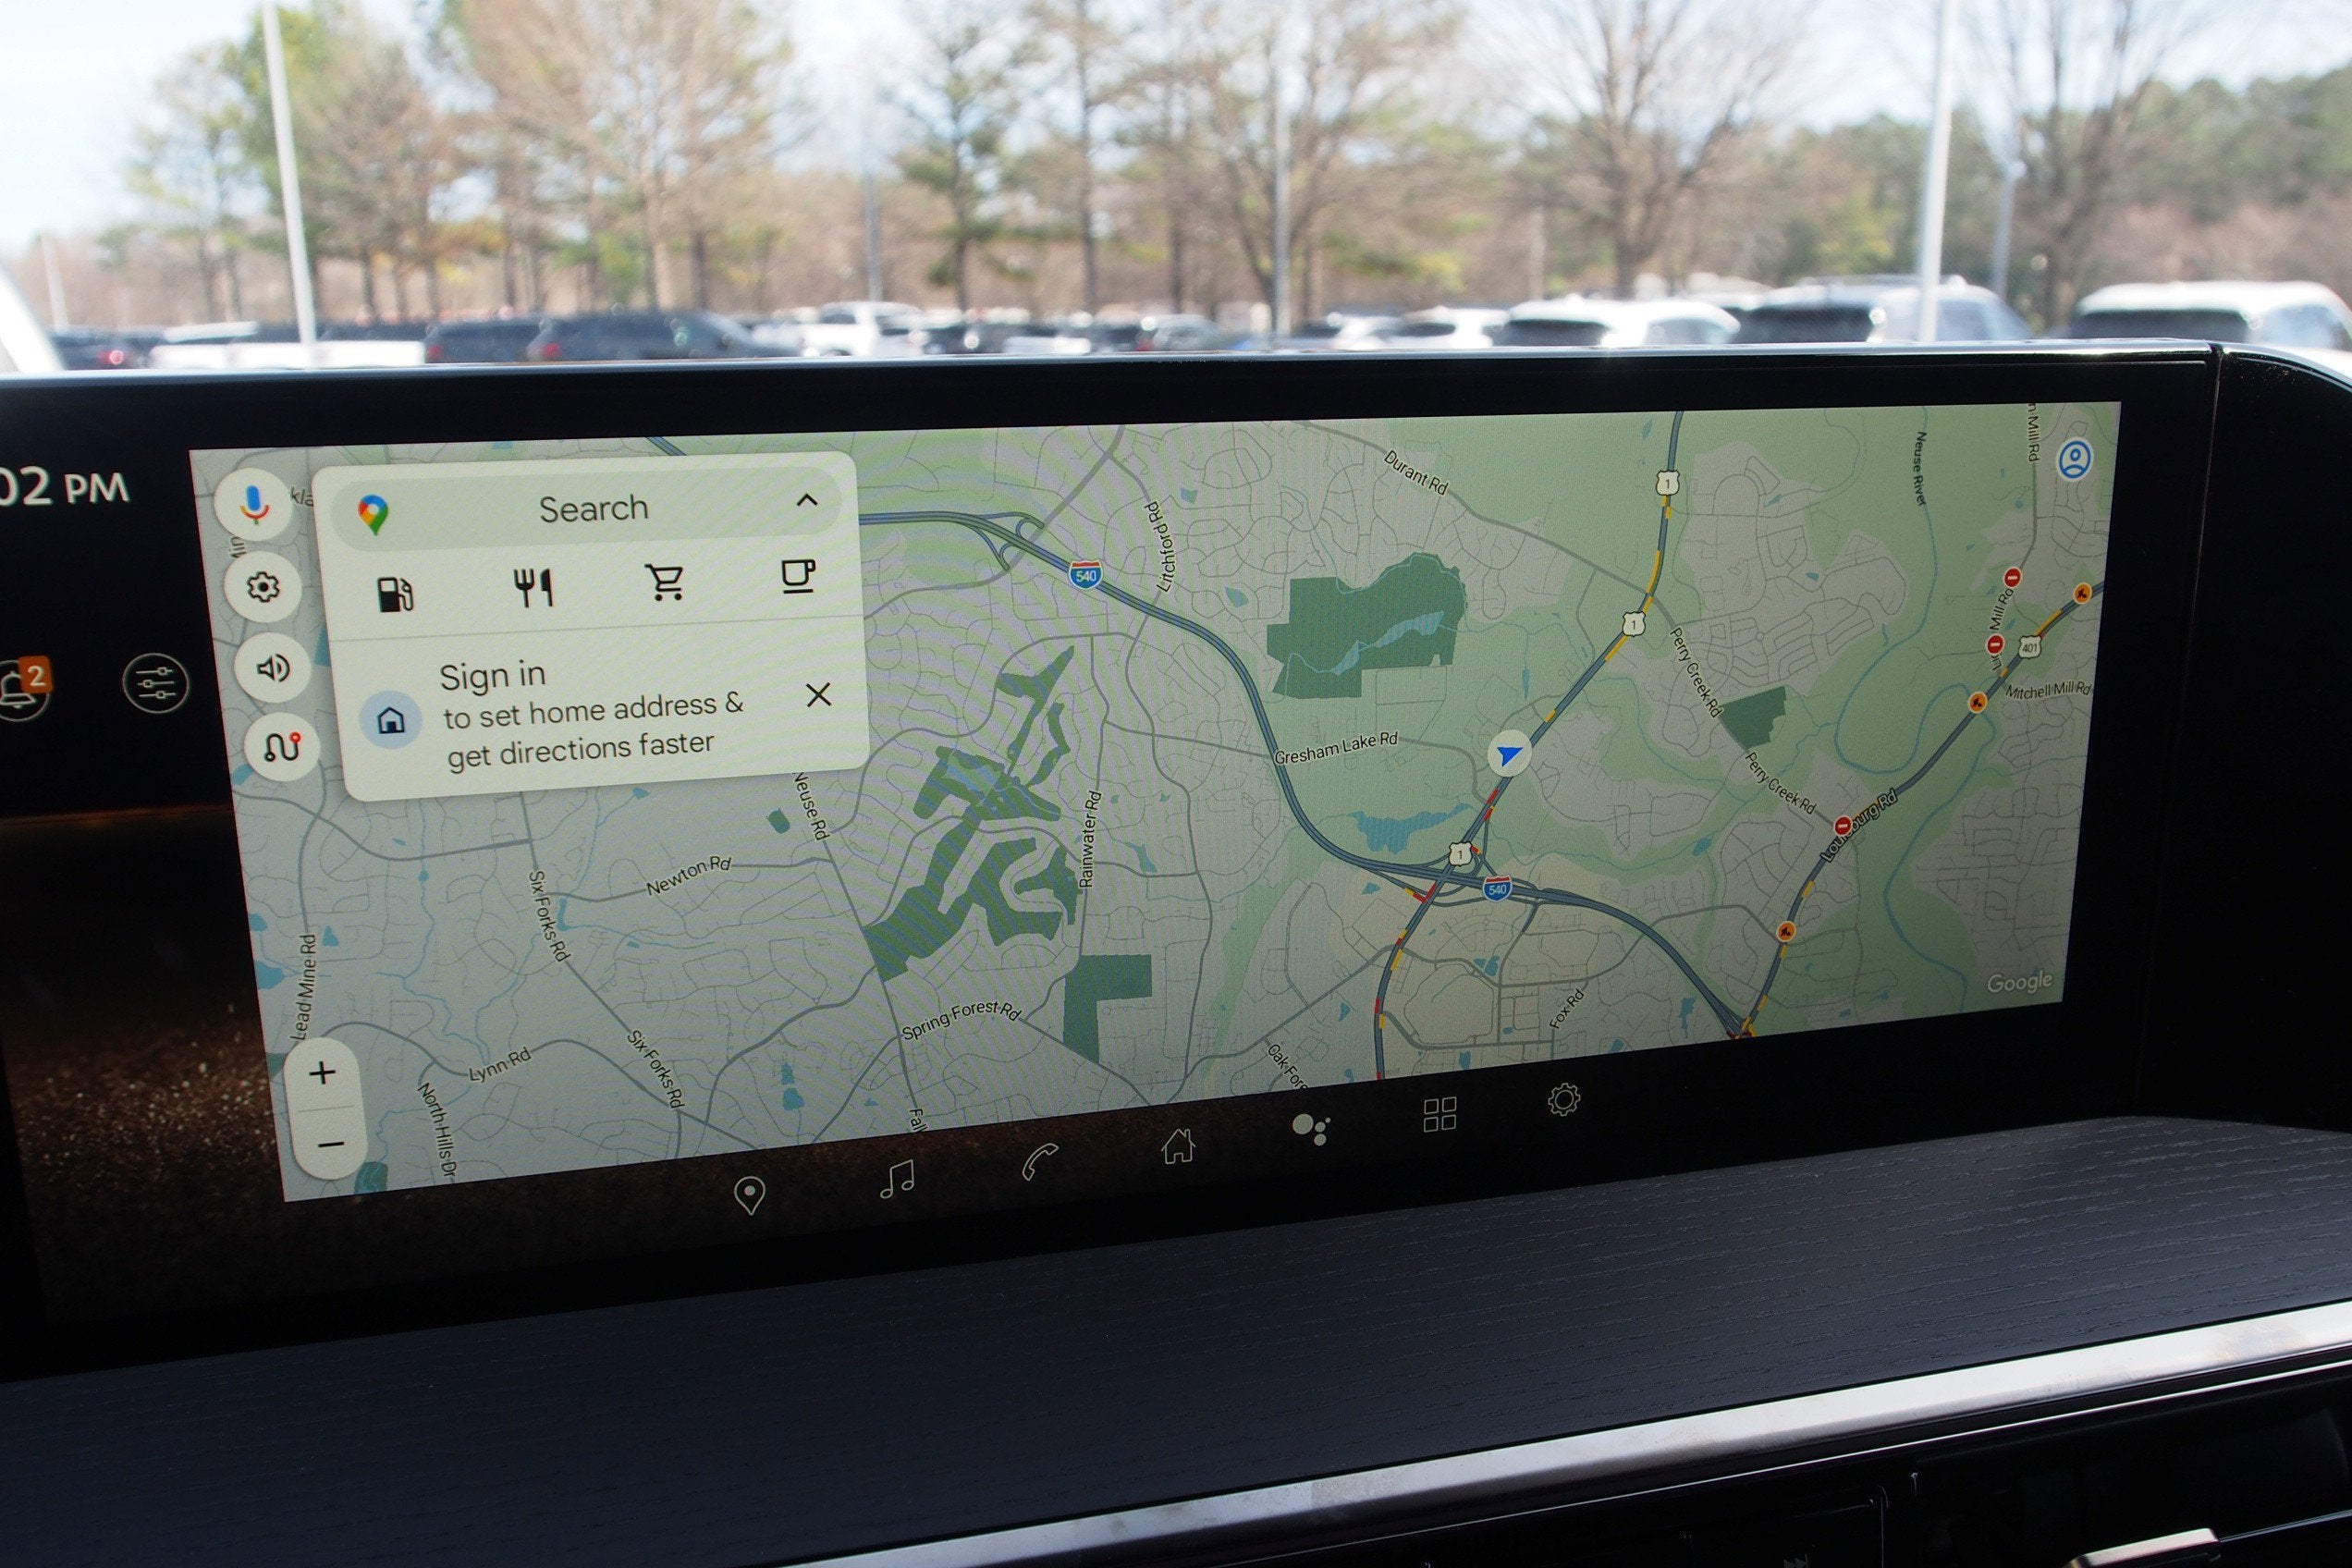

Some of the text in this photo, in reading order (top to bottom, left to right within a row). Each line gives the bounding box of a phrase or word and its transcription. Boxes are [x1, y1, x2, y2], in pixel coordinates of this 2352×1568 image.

[2027, 416, 2040, 441] Mill
[1914, 431, 1927, 507] Neuse River
[2028, 444, 2040, 462] Rd
[64, 472, 129, 504] PM
[1384, 450, 1449, 496] Durant Rd
[1665, 478, 1671, 489] 1
[539, 493, 649, 524] Search
[1145, 501, 1175, 593] Litchford Rd
[1075, 570, 1098, 583] 540
[1631, 619, 1636, 631] 1
[1990, 605, 2004, 631] Mill
[2022, 643, 2039, 654] 401
[27, 665, 45, 687] 2
[440, 659, 546, 697] Sign in
[1669, 627, 1722, 719] Perry Creek Rd
[2005, 681, 2092, 699] Mitchell Mill Rd
[445, 690, 744, 729] to set home address &
[448, 731, 715, 774] get directions faster
[1275, 730, 1399, 766] Gresham Lake Rd
[1746, 753, 1818, 815] Perry Creek Rd
[1877, 788, 1898, 810] Rd
[811, 820, 830, 840] Rd
[1079, 790, 1101, 889] Rainwater Rd
[1457, 849, 1463, 860] 1
[646, 855, 732, 896] Newton Rd
[1488, 884, 1507, 896] 540
[530, 870, 570, 962] Six Forks Rd
[291, 934, 316, 1041] Lead Mine Rd
[1987, 970, 2053, 995] Google
[902, 999, 1023, 1041] Spring Forest Rd
[1549, 988, 1585, 1030] Fox Rd
[470, 1047, 532, 1082] Lynn Rd
[628, 1030, 684, 1109] Six Forks Rd
[1268, 1044, 1289, 1070] Oak
[418, 1083, 456, 1178] North Hills Dr
